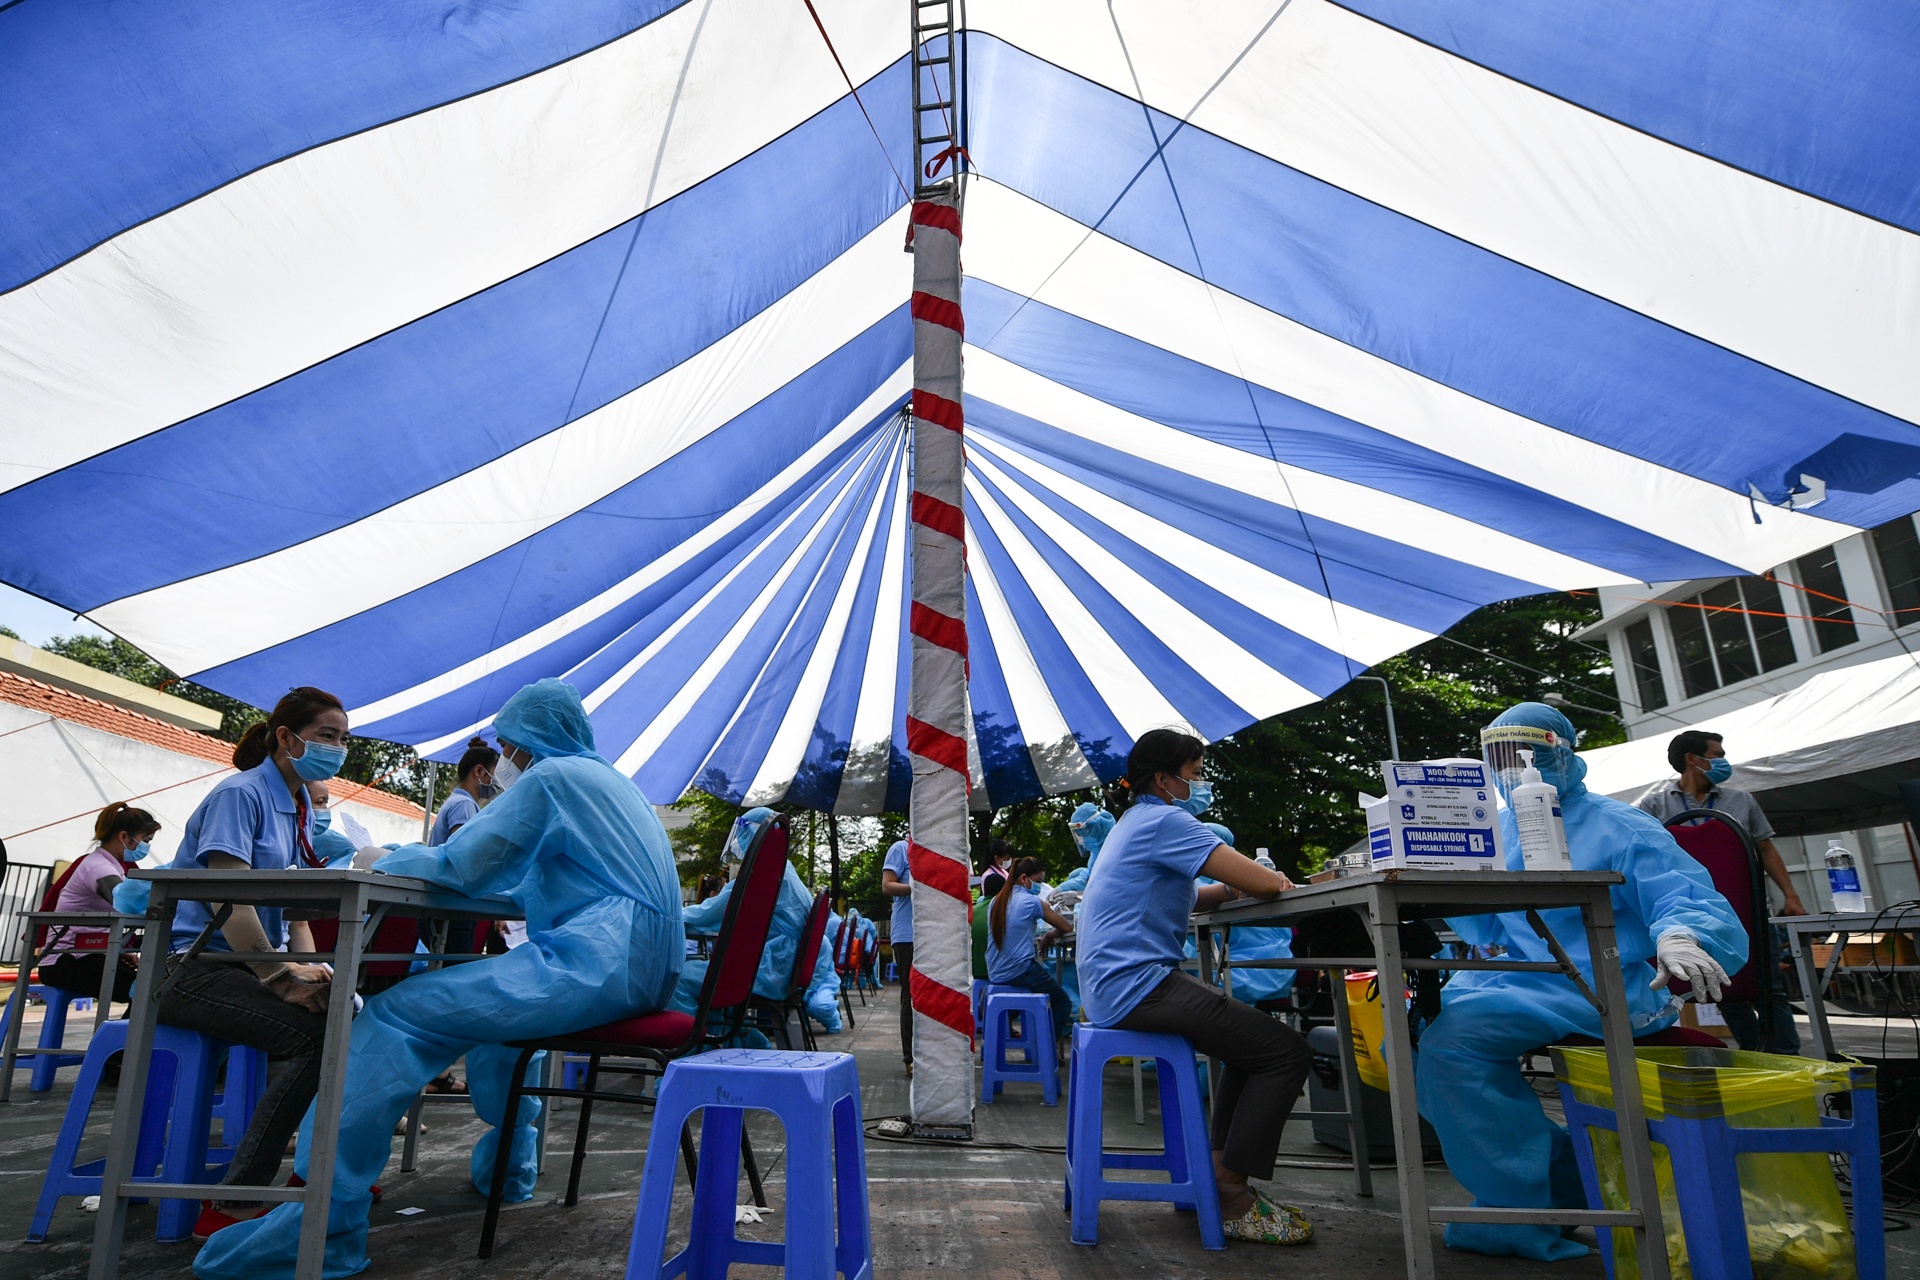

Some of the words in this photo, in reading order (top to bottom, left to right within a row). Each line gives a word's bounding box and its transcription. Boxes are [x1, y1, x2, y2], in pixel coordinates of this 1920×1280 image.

[1426, 768, 1481, 778] VINAHKOOK
[1406, 831, 1467, 842] VINAHANKOOK
[1474, 837, 1479, 849] 1
[1410, 844, 1443, 852] DISPOSABLE
[1444, 845, 1466, 853] SYRINGE
